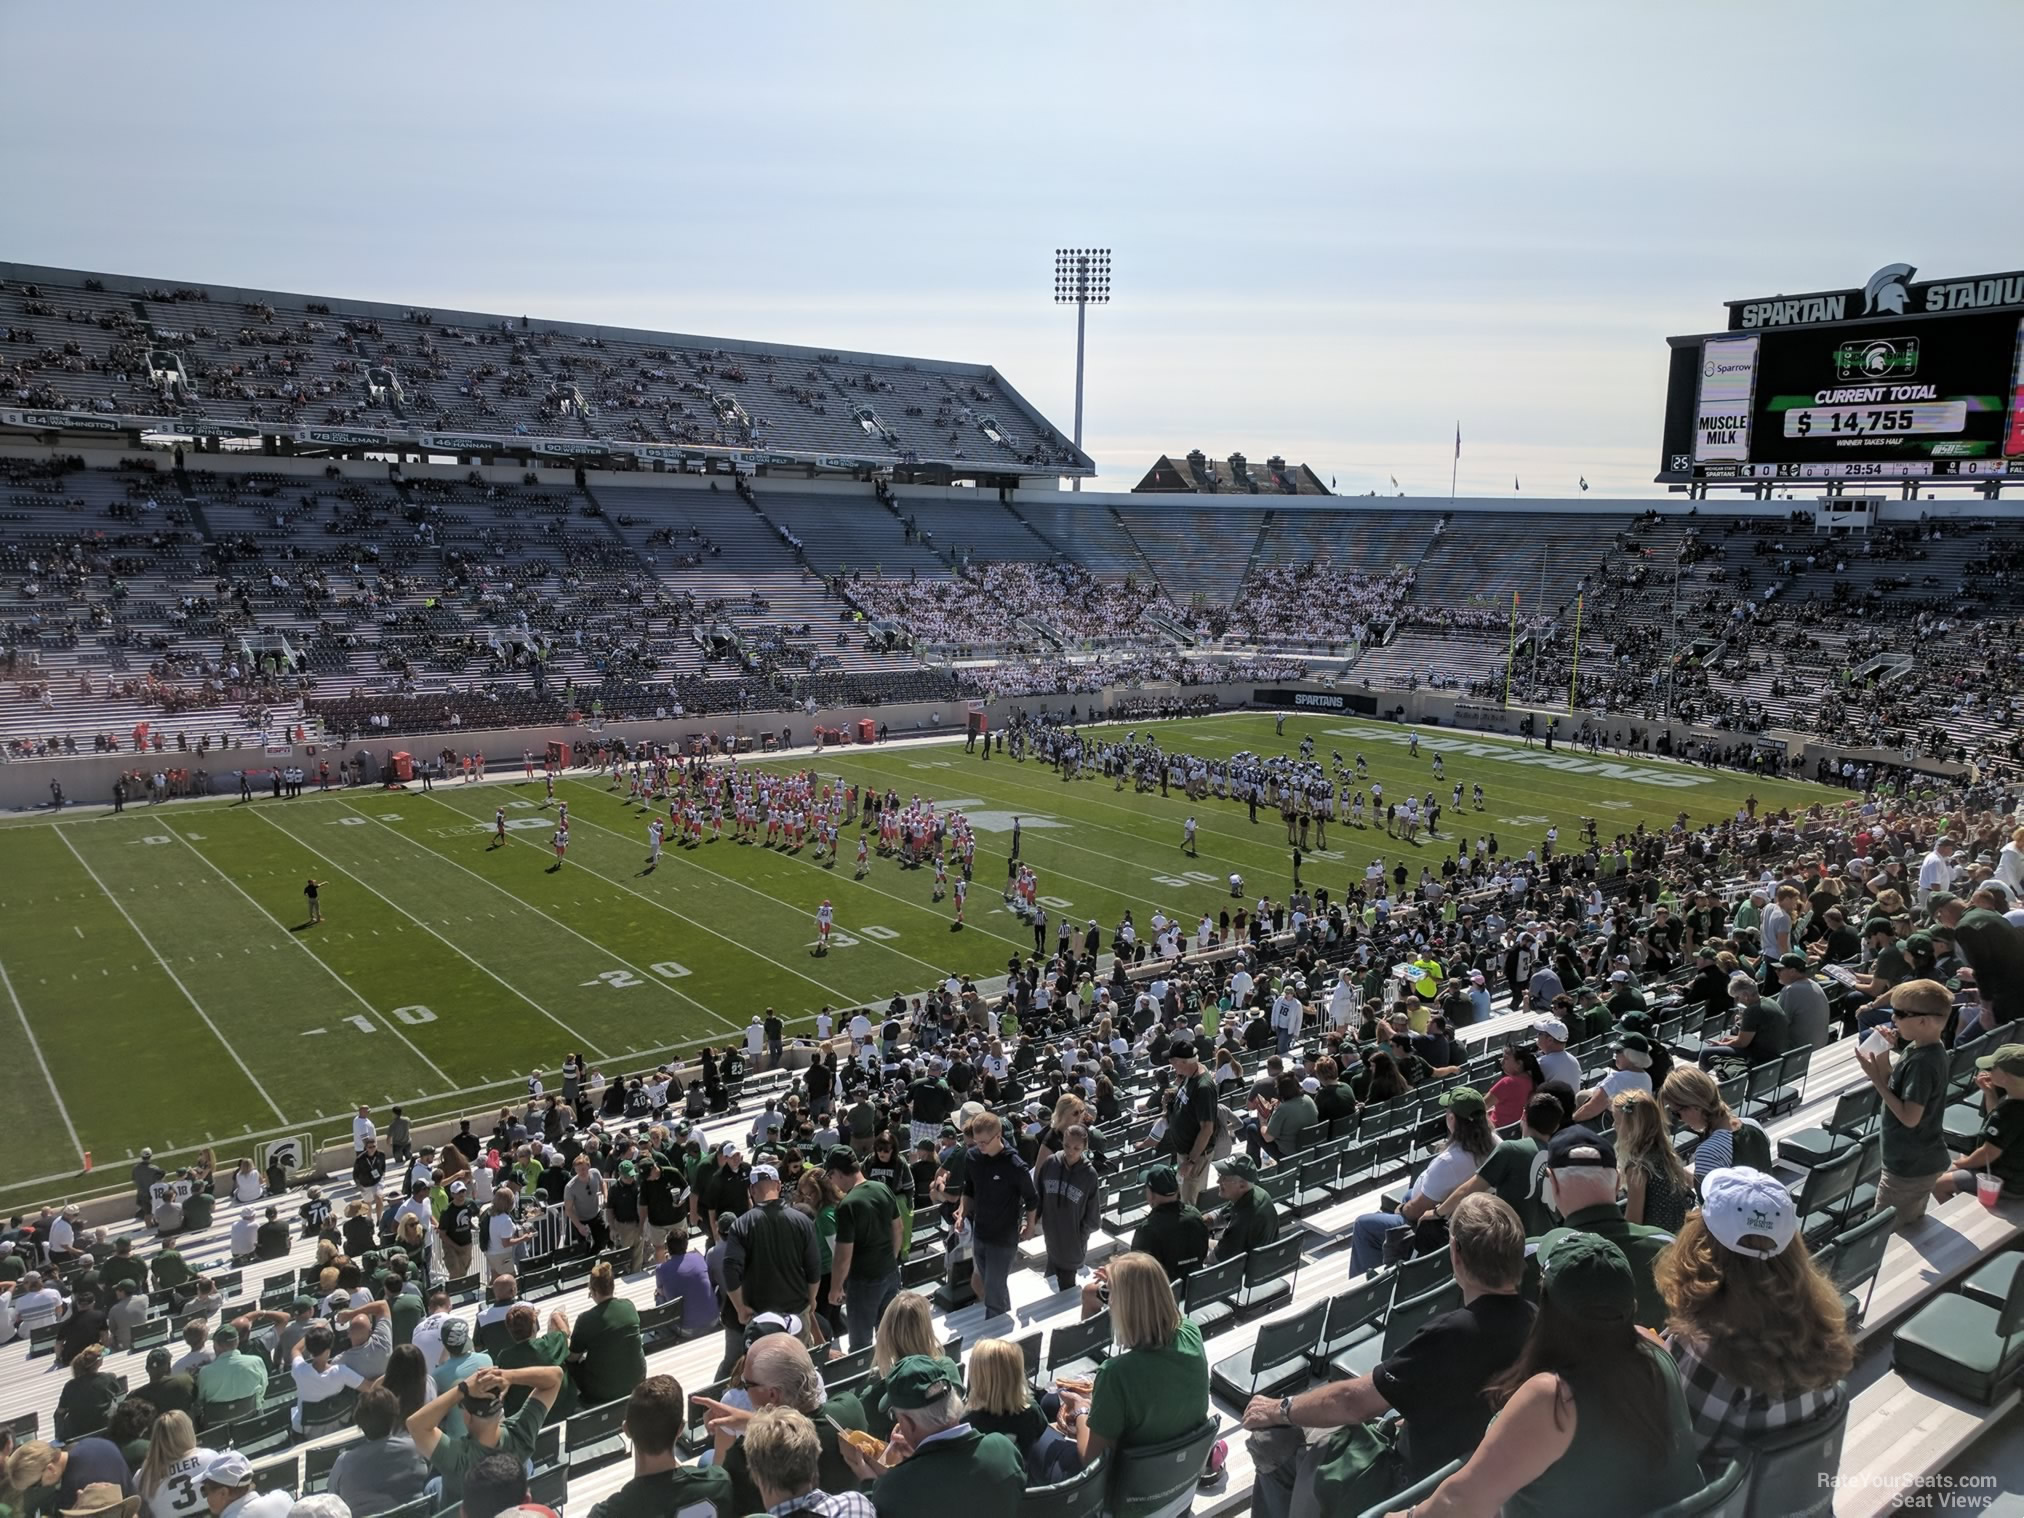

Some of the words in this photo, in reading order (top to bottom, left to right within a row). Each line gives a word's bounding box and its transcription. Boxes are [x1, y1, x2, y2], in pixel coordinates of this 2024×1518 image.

[1742, 296, 1846, 328] SPARTAN
[1717, 364, 1752, 374] Sparrow
[1815, 387, 1886, 404] CURRENT
[1890, 384, 1937, 401] TOTAL
[27, 416, 46, 424] 84
[50, 420, 114, 428] WASHINGTON
[1699, 416, 1747, 430] MUSCLE
[1798, 411, 1811, 436] $
[1831, 410, 1914, 436] 14,755
[1706, 430, 1736, 445] MILK
[1836, 438, 1862, 446] WINNER
[1674, 457, 1688, 469] 25
[1969, 463, 1976, 473] 0
[1763, 466, 1770, 475] 0
[1845, 464, 1882, 475] 29:54
[1295, 694, 1343, 707] SPARTANS
[1322, 728, 1717, 788] SPARTANS
[1280, 1006, 1289, 1016] 18
[731, 1064, 743, 1075] 23
[994, 1061, 1000, 1071] 3
[633, 1096, 646, 1108] 40
[154, 1188, 164, 1199] 18
[177, 1186, 188, 1196] 18
[309, 1206, 329, 1224] 70
